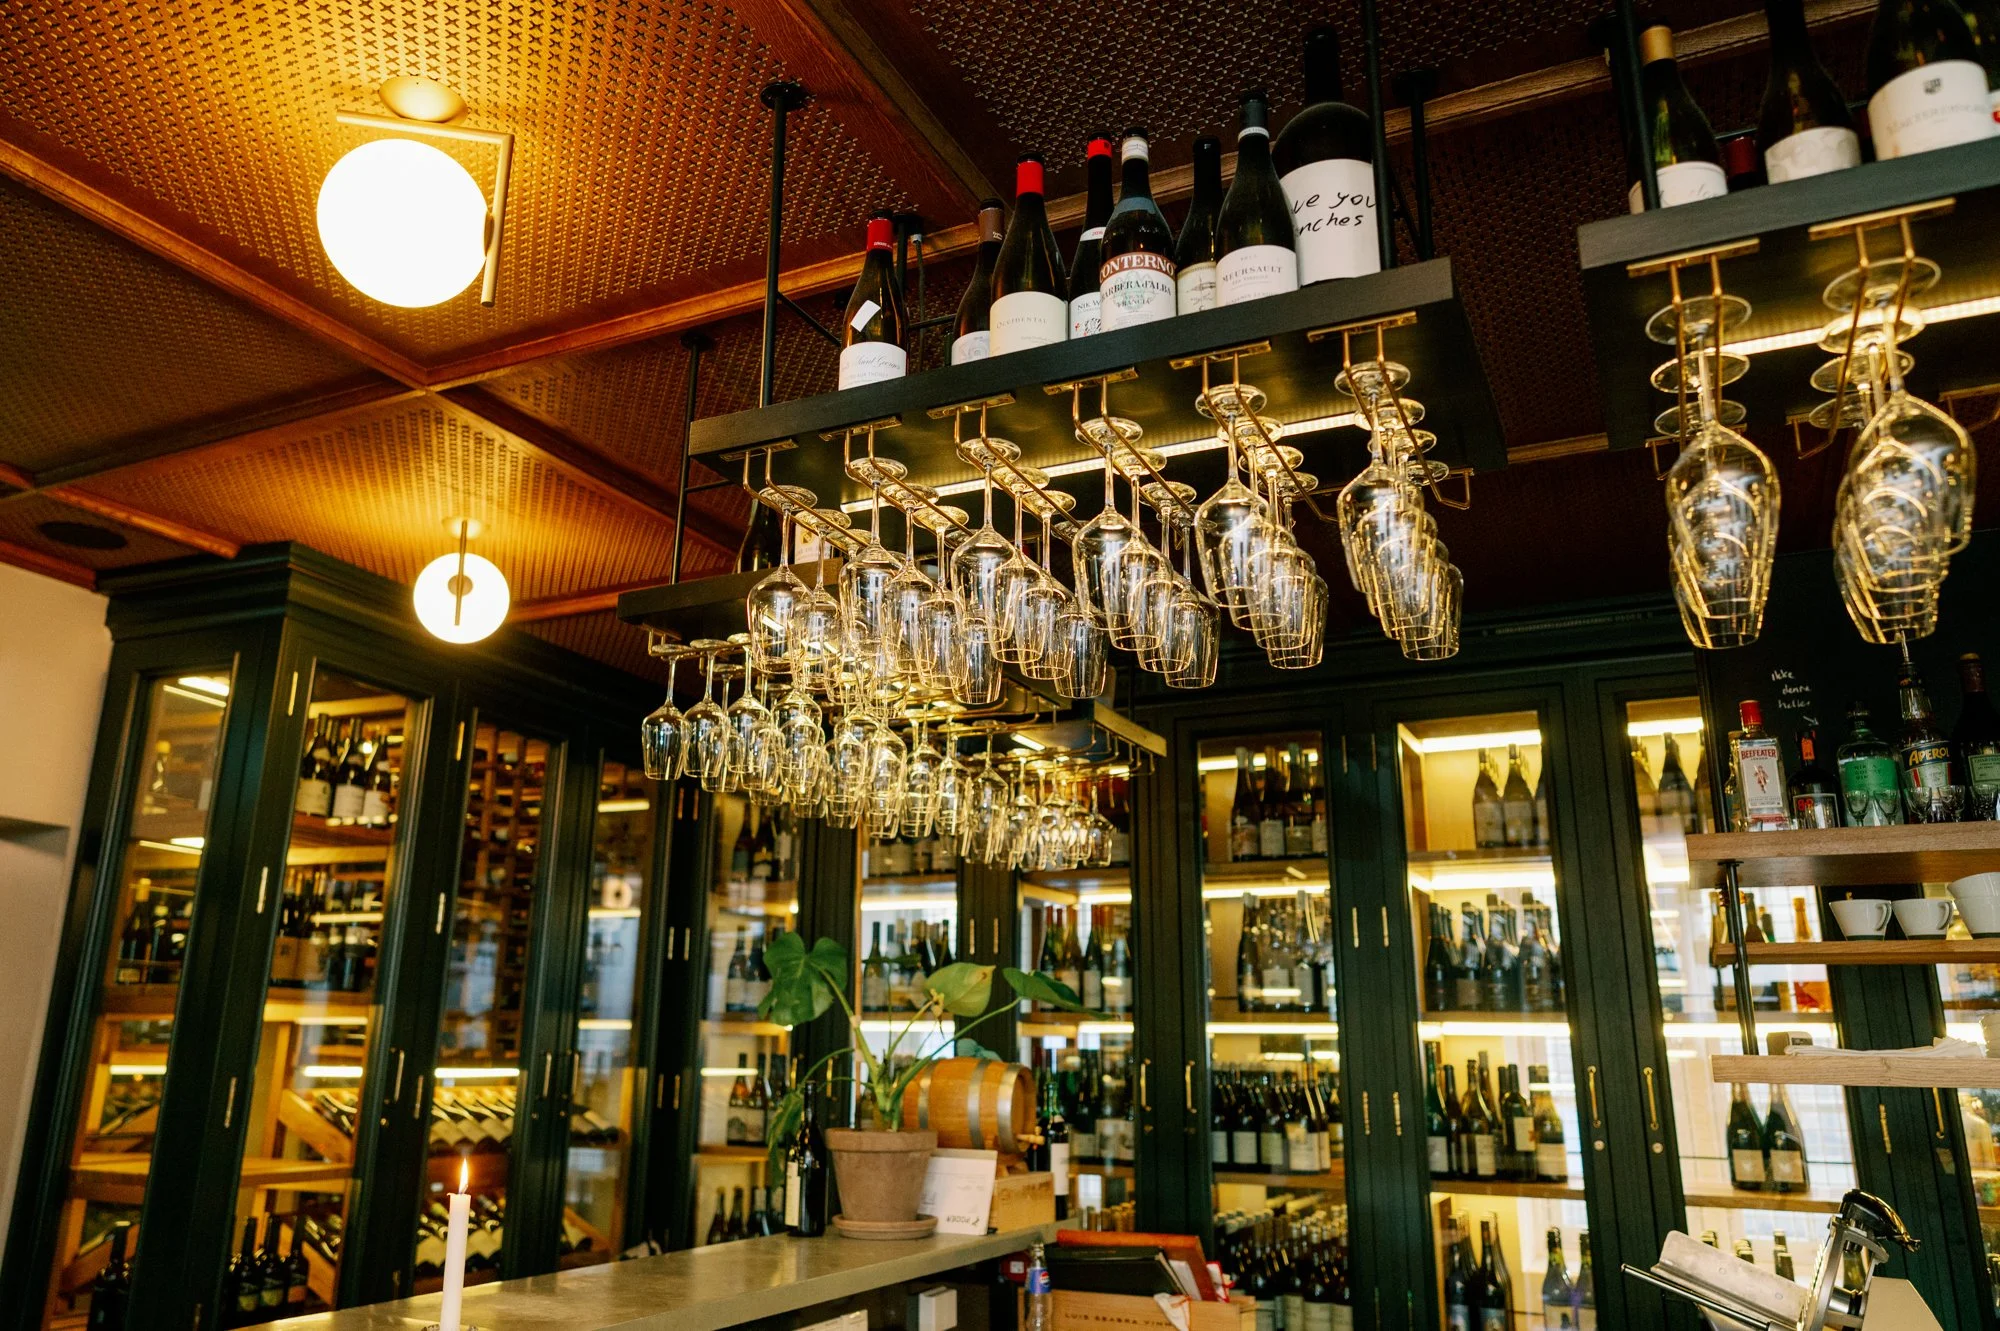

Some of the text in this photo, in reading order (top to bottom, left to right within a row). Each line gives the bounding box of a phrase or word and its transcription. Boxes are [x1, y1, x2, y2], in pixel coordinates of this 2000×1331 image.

[1223, 265, 1283, 282] MEURSAULT
[996, 316, 1048, 329] OCCIDENTAL
[1740, 748, 1777, 761] BEEFEATER
